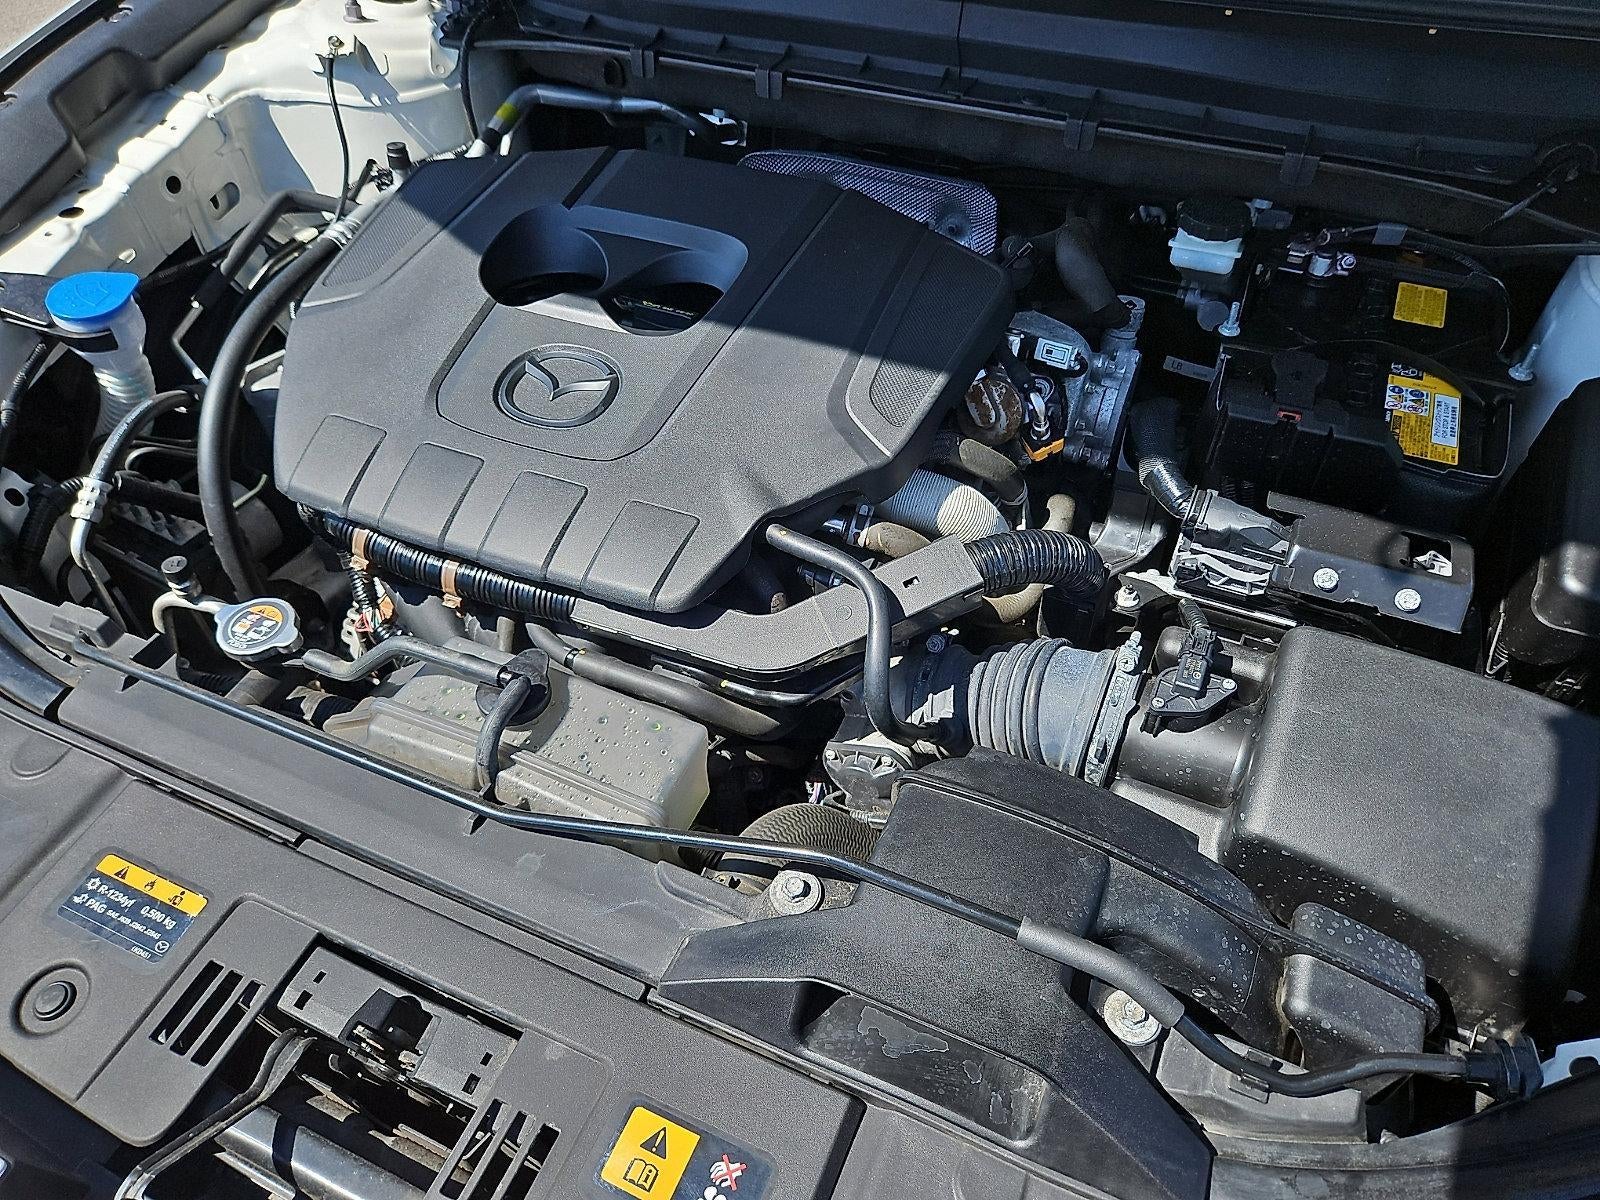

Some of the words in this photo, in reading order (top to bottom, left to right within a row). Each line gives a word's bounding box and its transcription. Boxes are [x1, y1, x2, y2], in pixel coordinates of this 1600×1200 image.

[85, 898, 107, 913] PAG
[107, 910, 119, 919] SAE
[98, 885, 136, 908] R-1234yf
[163, 916, 177, 929] kg
